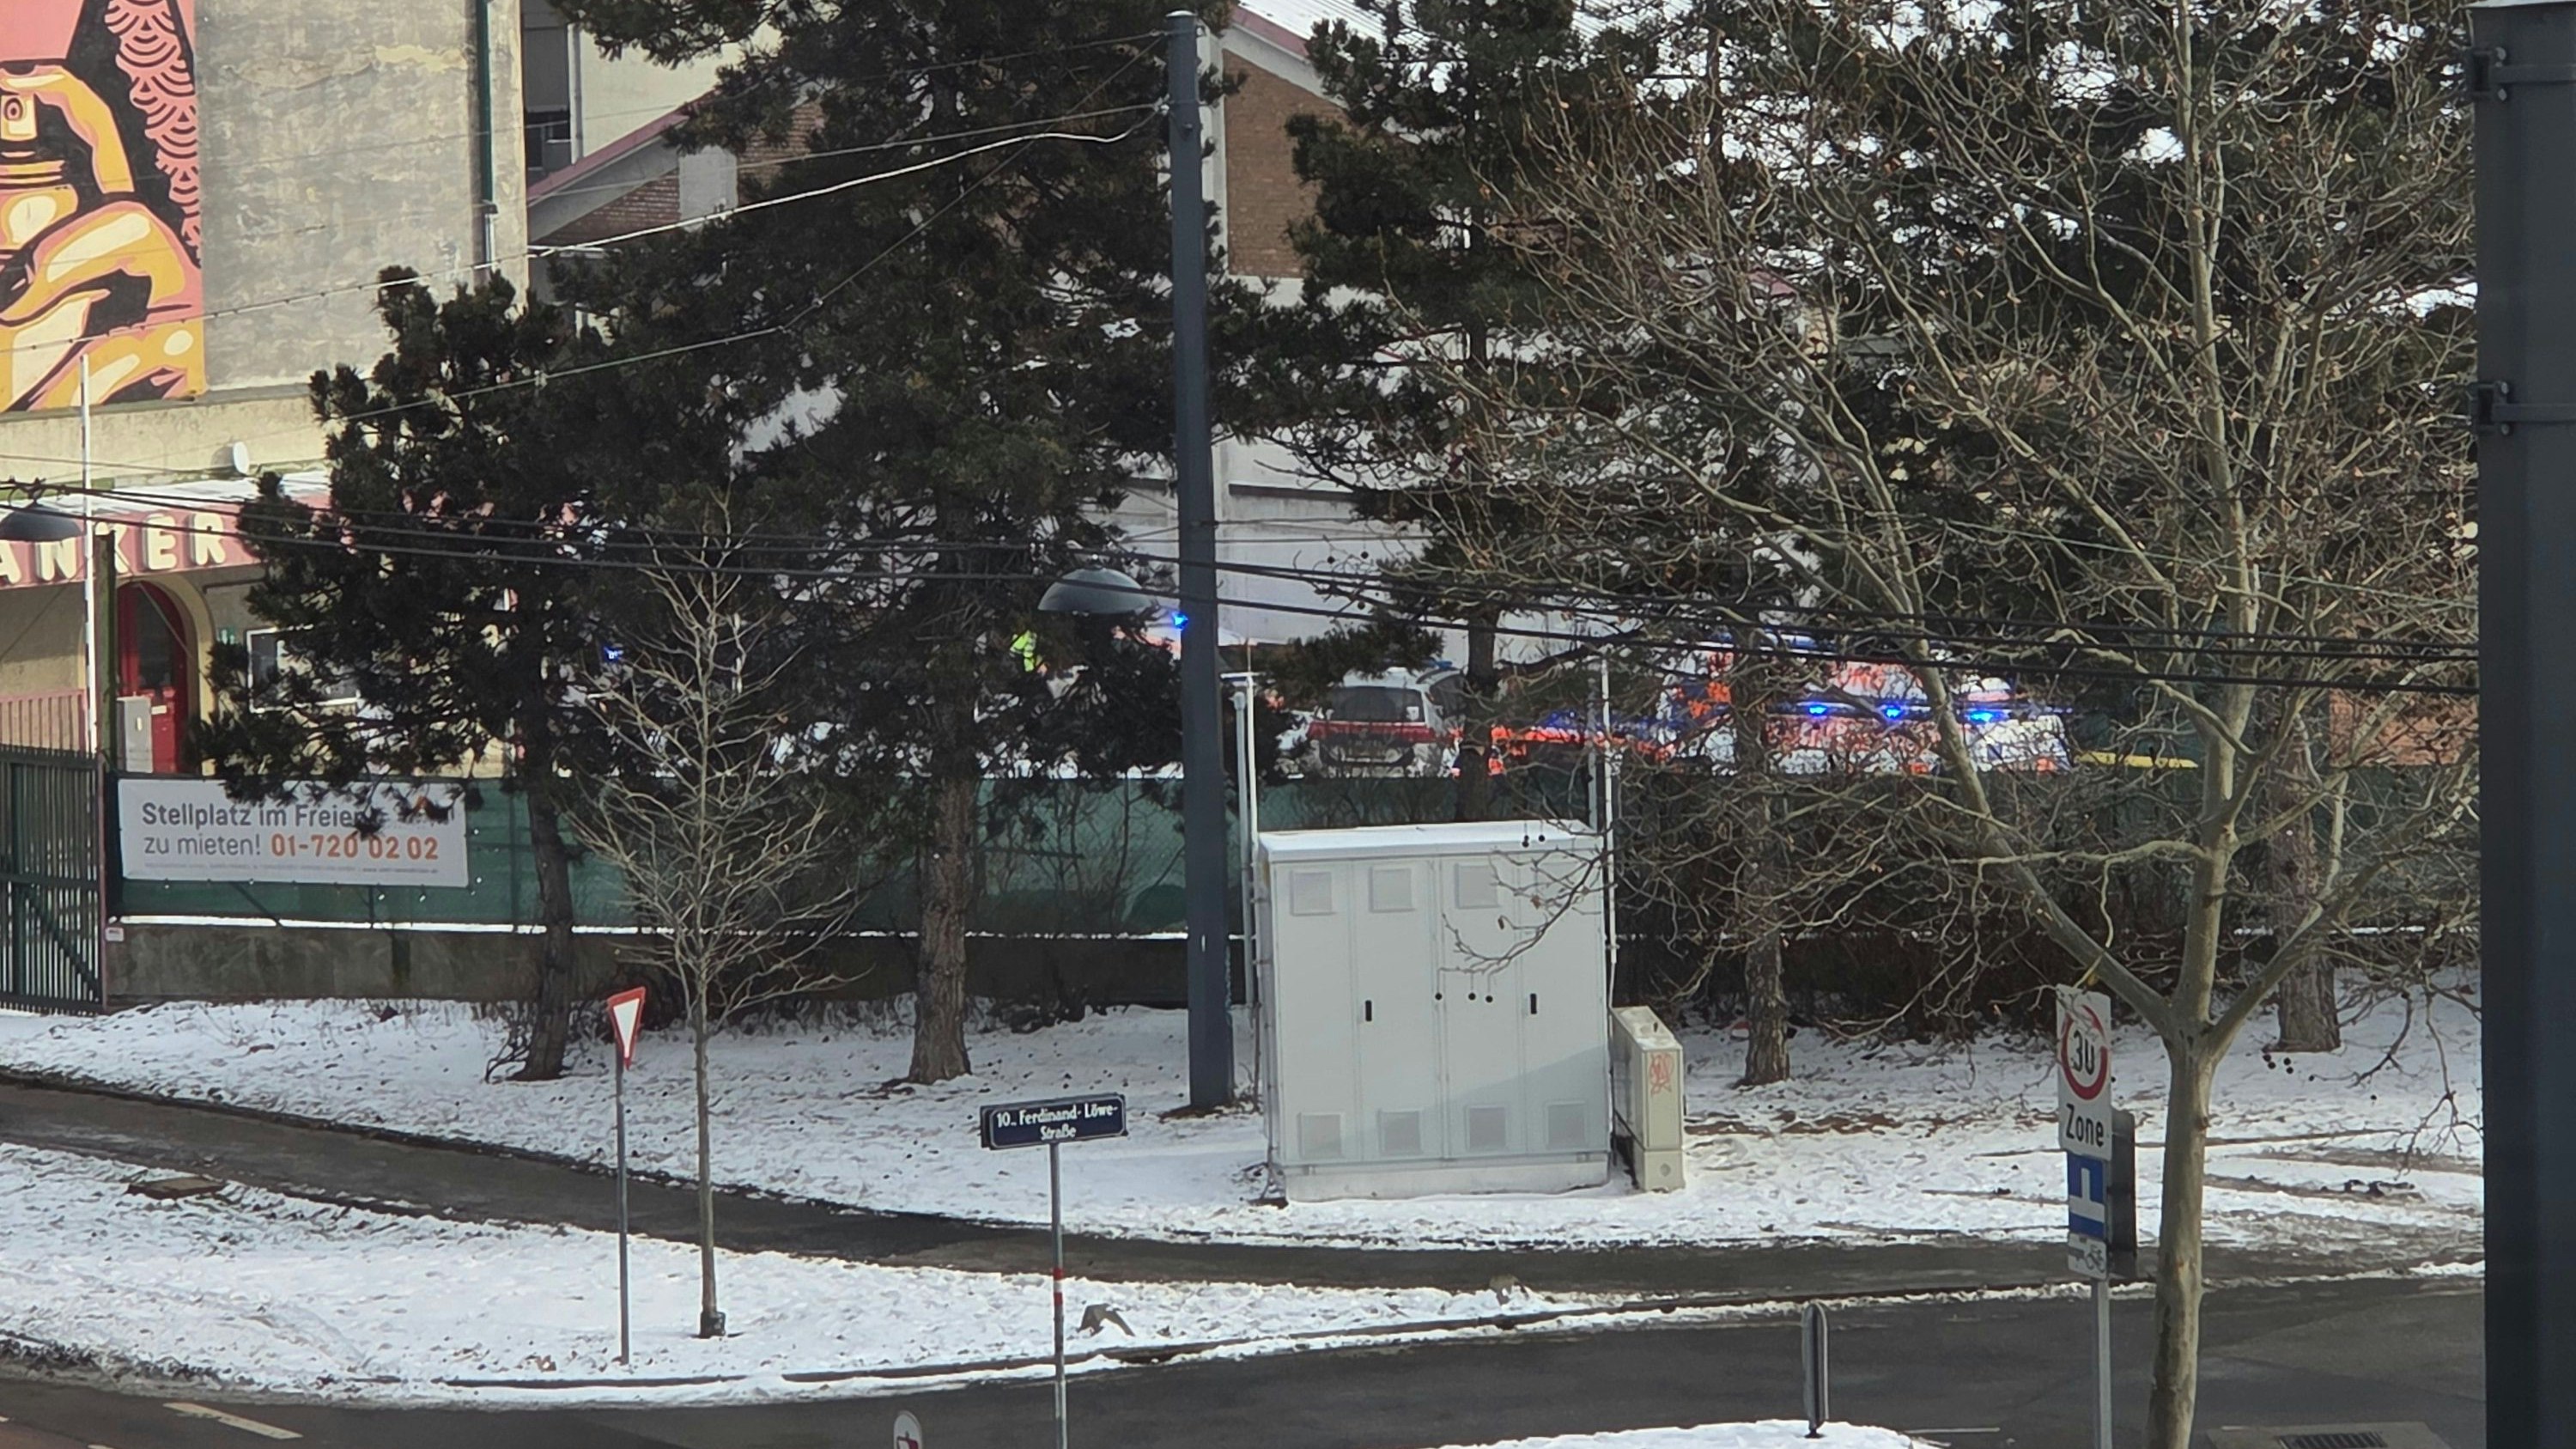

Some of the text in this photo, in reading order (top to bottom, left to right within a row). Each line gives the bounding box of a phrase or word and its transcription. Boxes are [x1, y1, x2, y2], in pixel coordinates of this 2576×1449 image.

[143, 801, 252, 831] Stellplatz
[259, 804, 287, 827] im
[144, 832, 439, 860] zu mieten! 01-720 02 02
[2071, 1029, 2095, 1075] 30
[1040, 1123, 1077, 1141] Straße
[2066, 1103, 2104, 1148] Zone
